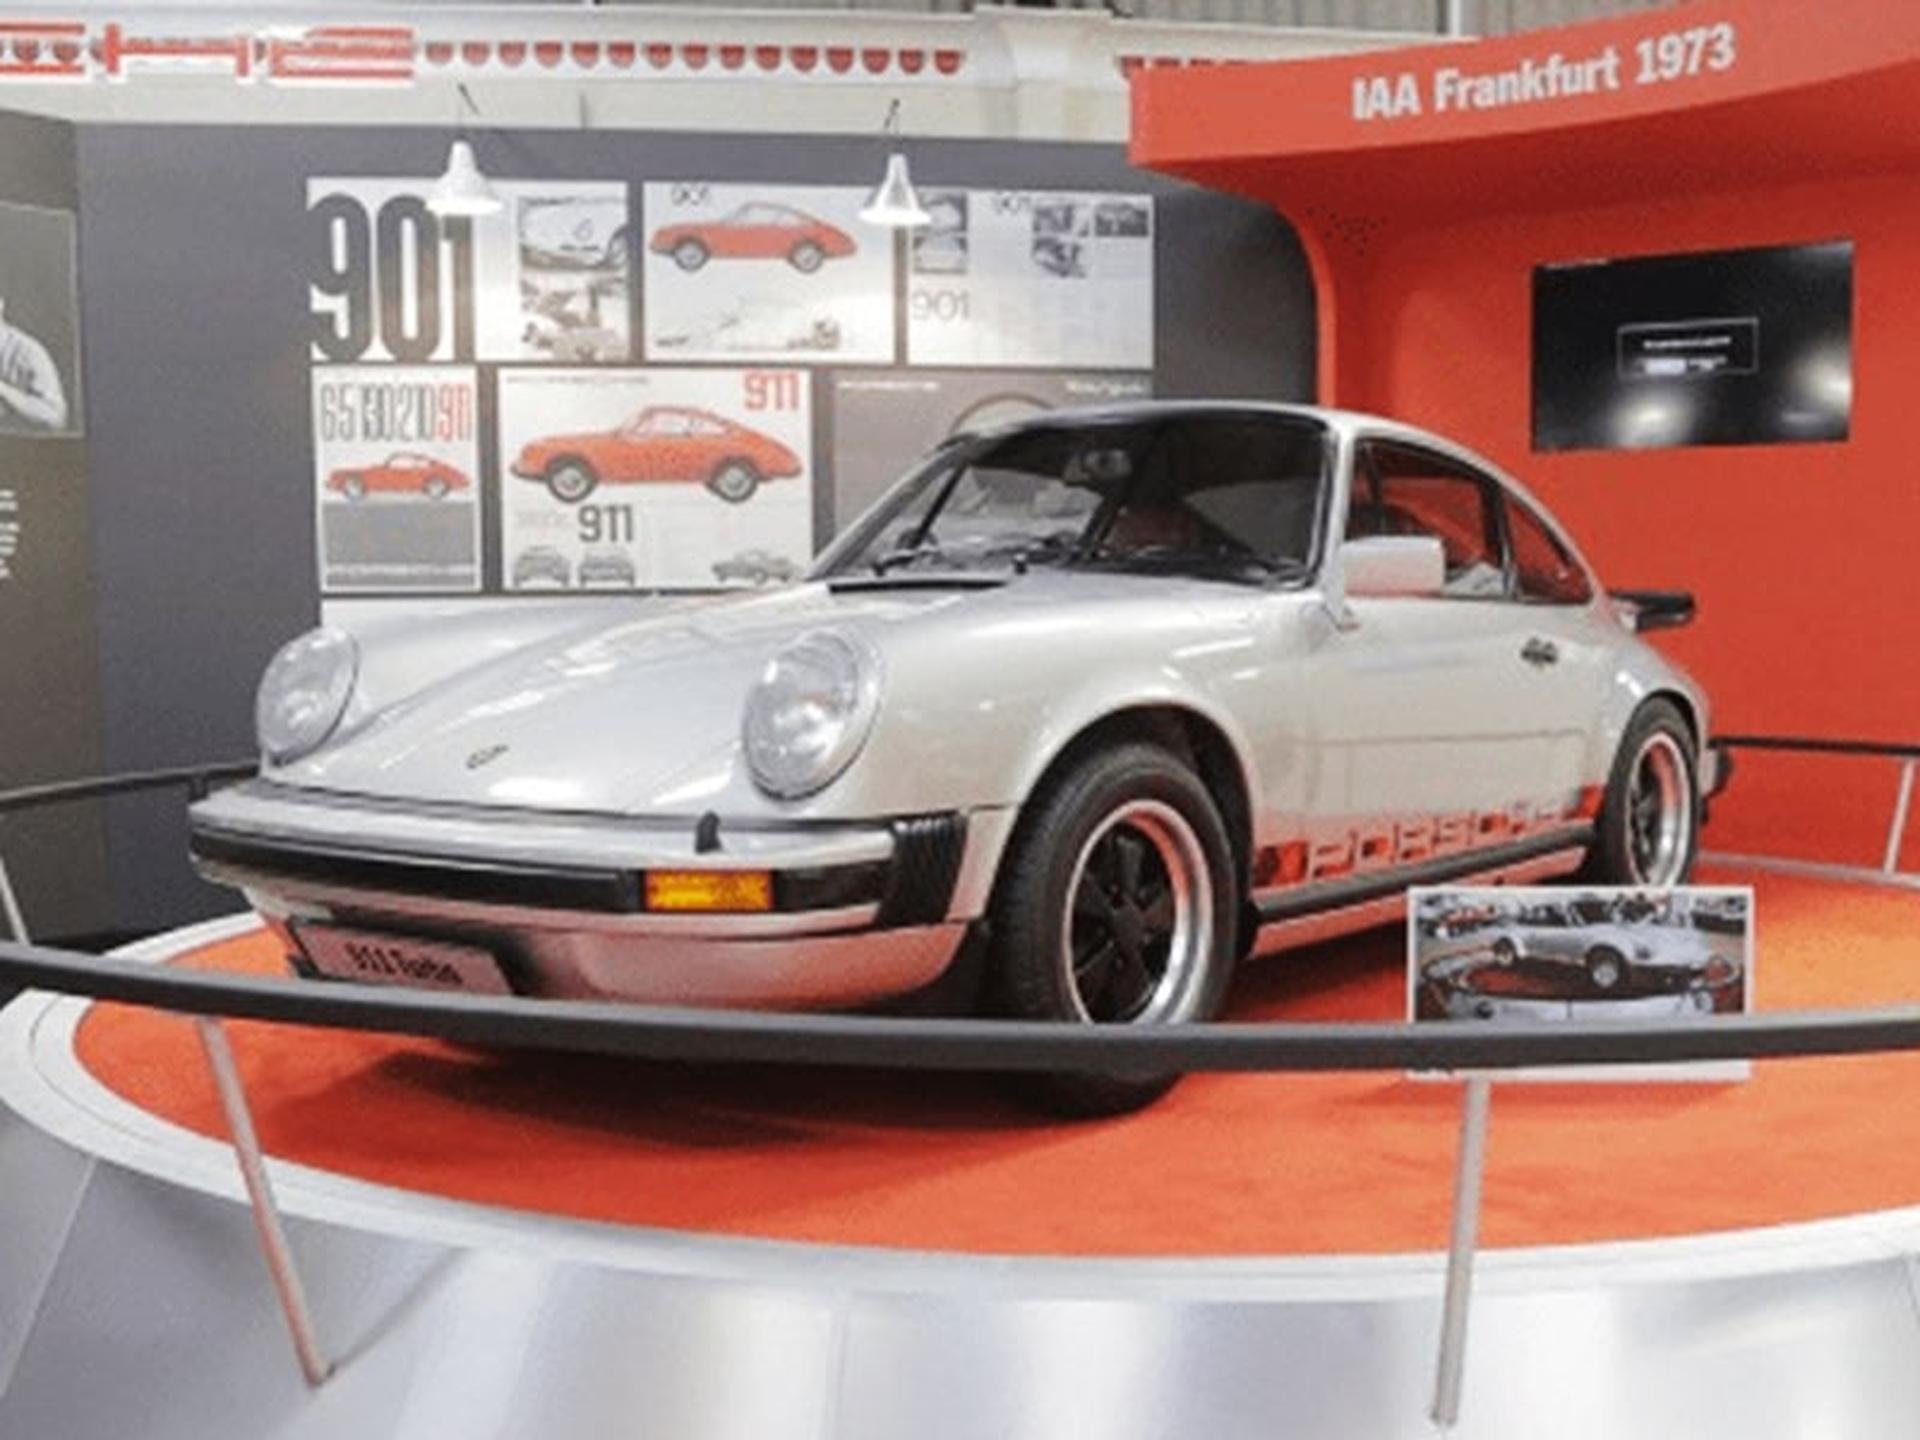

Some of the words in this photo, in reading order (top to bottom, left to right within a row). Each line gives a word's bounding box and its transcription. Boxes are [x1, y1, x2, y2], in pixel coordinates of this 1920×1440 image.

[1352, 74, 1421, 121] IAA
[1433, 46, 1620, 112] Frankfurt
[1634, 22, 1736, 85] 1973
[307, 192, 476, 361] 901
[744, 373, 800, 410] 911
[578, 504, 634, 543] 911
